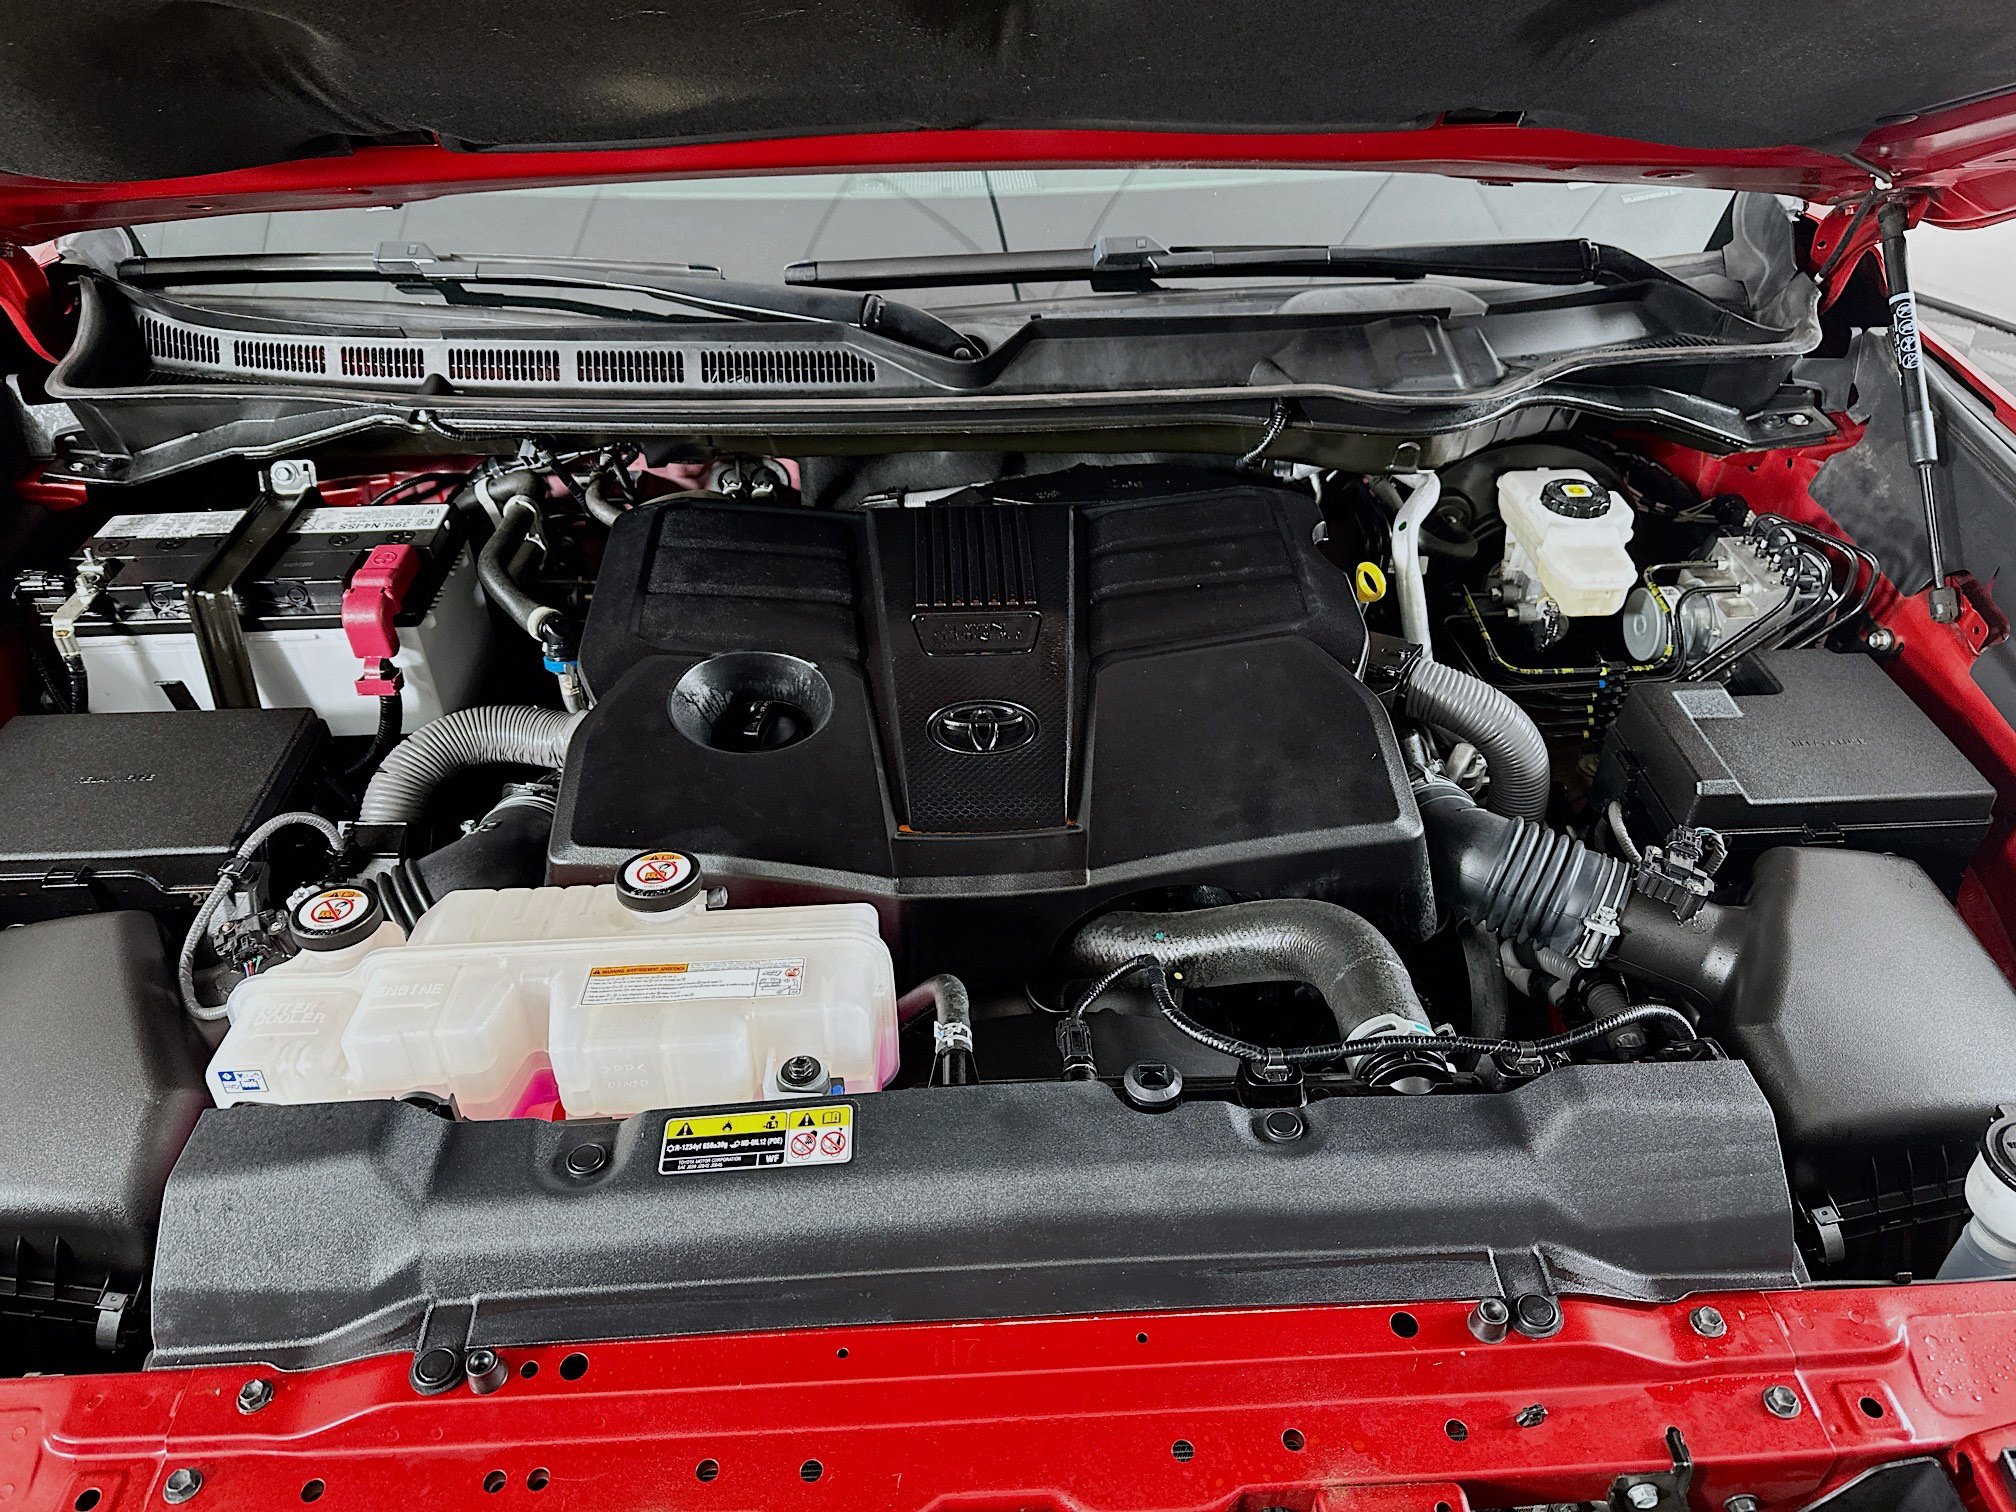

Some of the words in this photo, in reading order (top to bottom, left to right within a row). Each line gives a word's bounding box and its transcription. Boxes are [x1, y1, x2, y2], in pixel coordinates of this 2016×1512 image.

[339, 521, 410, 530] 395LN4-ISS
[375, 983, 444, 997] ENGINE
[674, 1142, 702, 1151] R-1234yf
[767, 1137, 783, 1146] (POE)
[765, 1154, 780, 1163] WF
